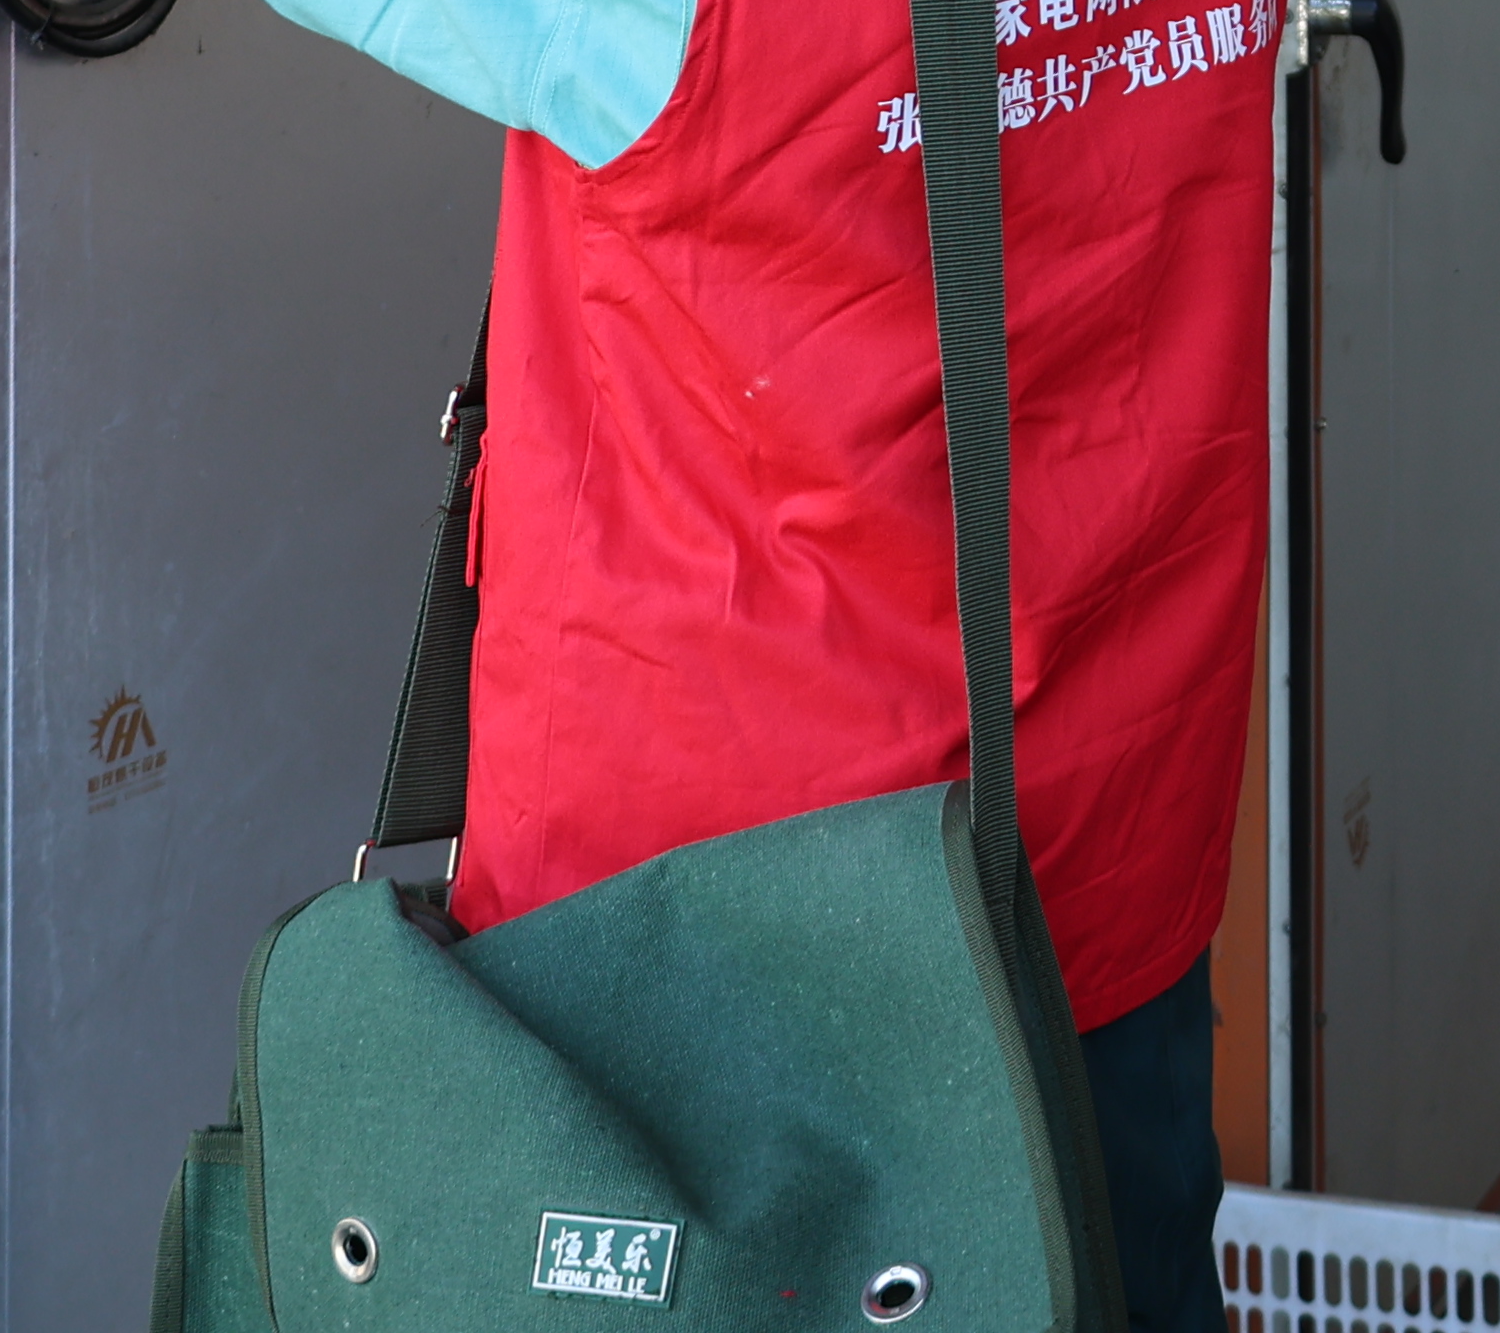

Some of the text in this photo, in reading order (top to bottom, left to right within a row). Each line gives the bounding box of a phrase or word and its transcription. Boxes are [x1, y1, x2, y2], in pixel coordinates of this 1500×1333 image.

[551, 1226, 652, 1274] 恒美乐
[548, 1268, 647, 1294] HENG MEI LE
